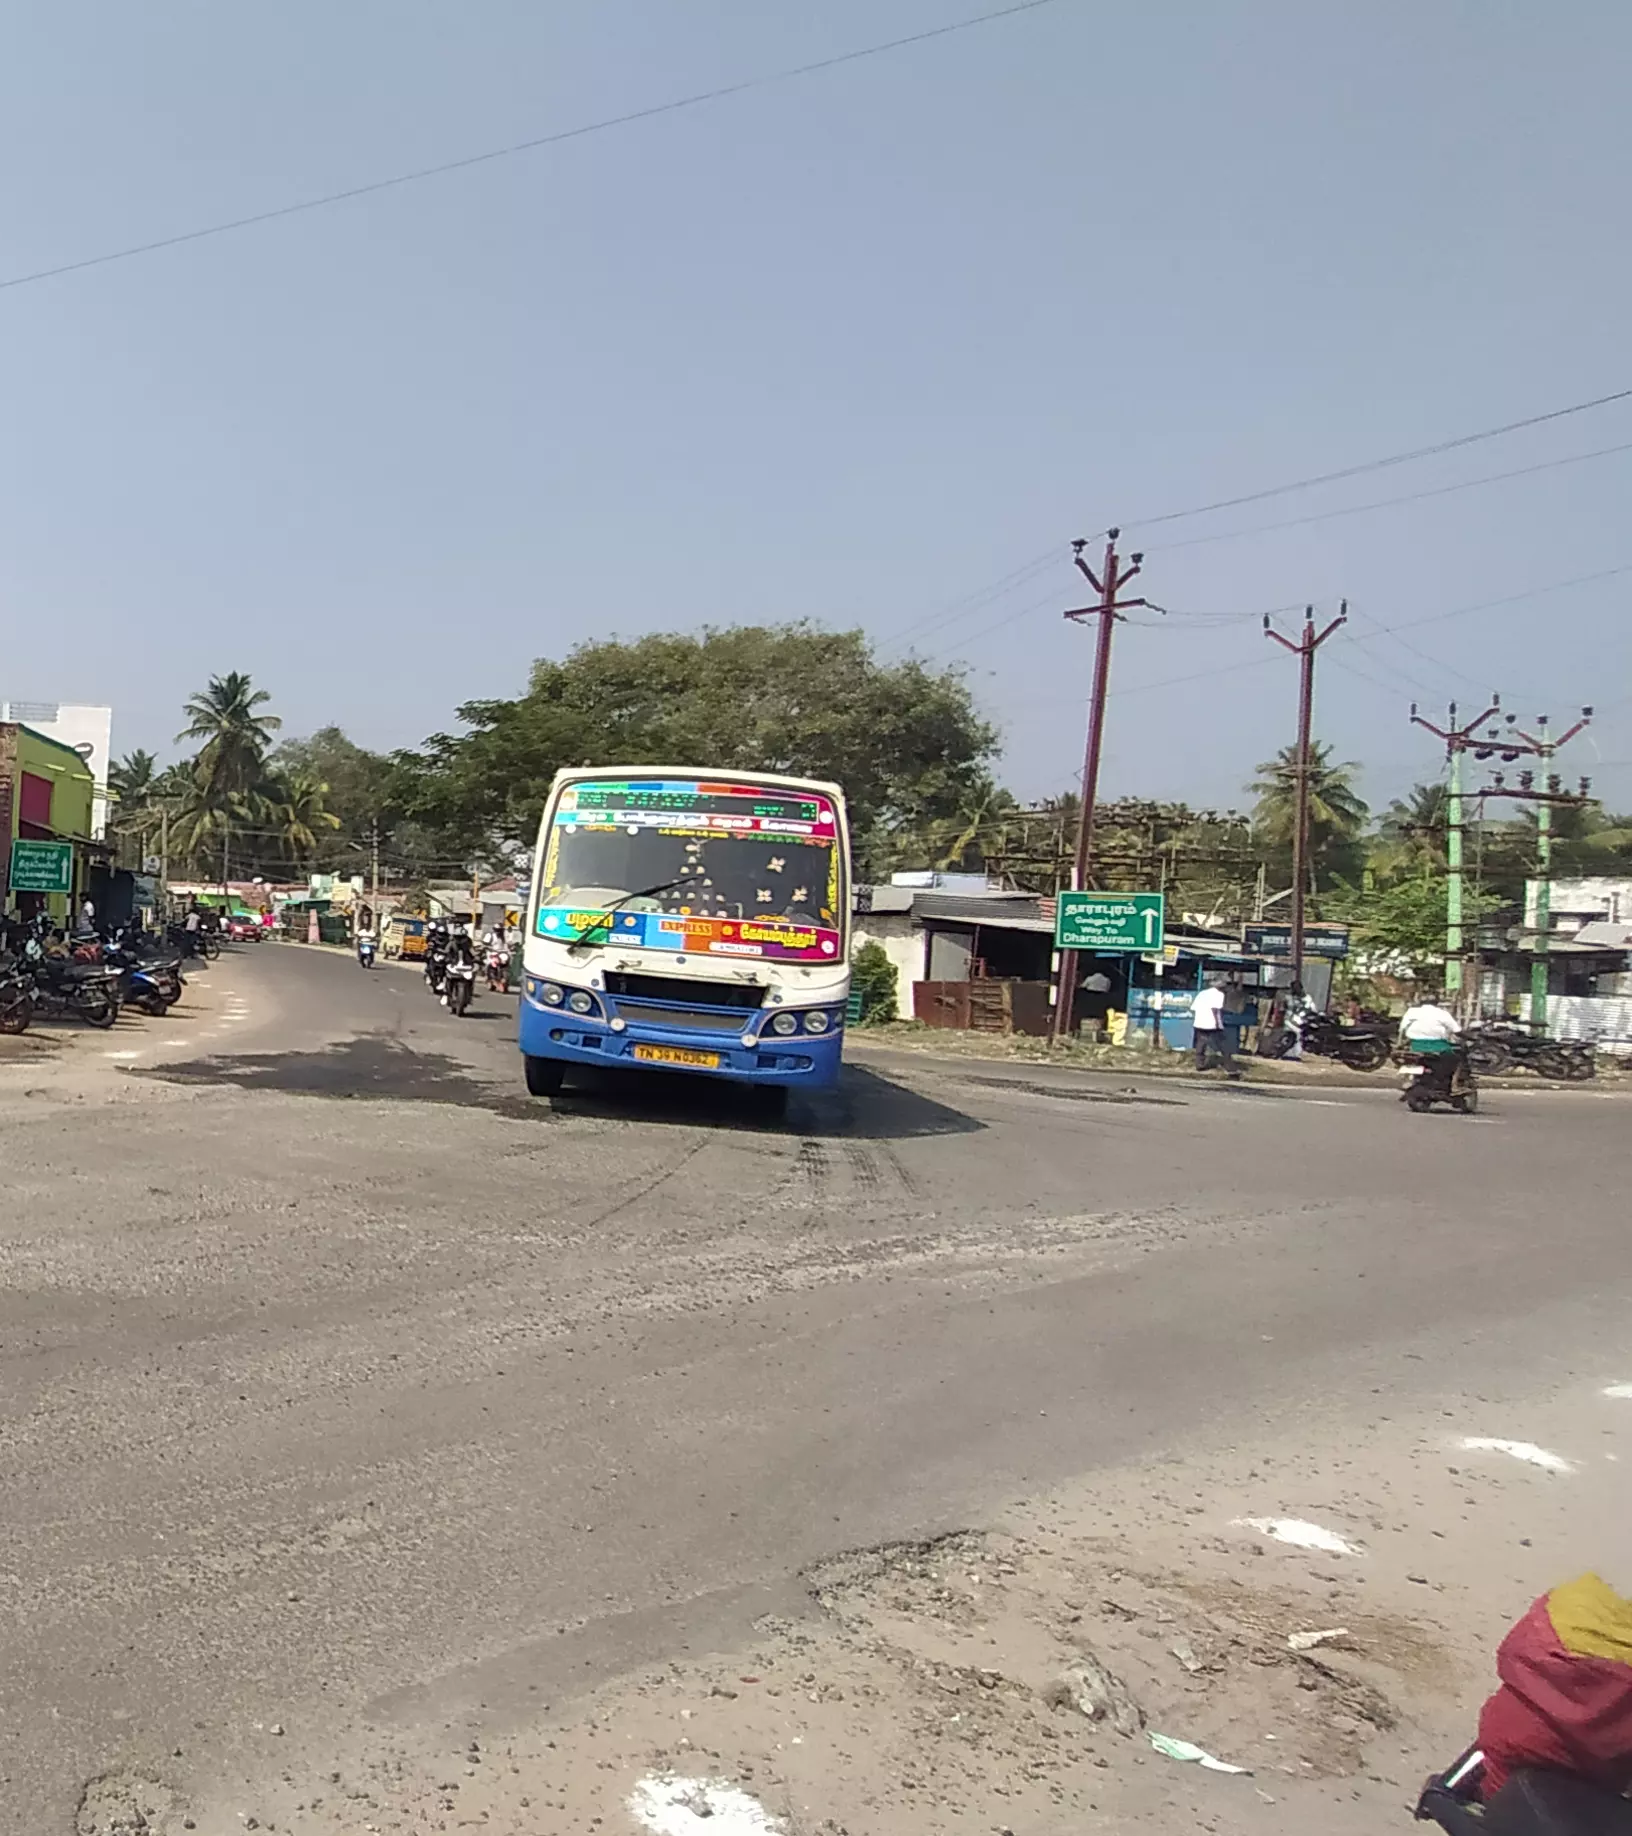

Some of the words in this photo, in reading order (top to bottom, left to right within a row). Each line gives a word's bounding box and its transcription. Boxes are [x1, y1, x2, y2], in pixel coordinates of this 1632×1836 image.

[1064, 902, 1137, 917] தாராபுரம்
[660, 920, 711, 935] EXPRESS
[1080, 926, 1103, 935] Way
[1104, 926, 1118, 934] To
[1063, 932, 1135, 945] Dharapuram
[638, 1047, 653, 1059] TN
